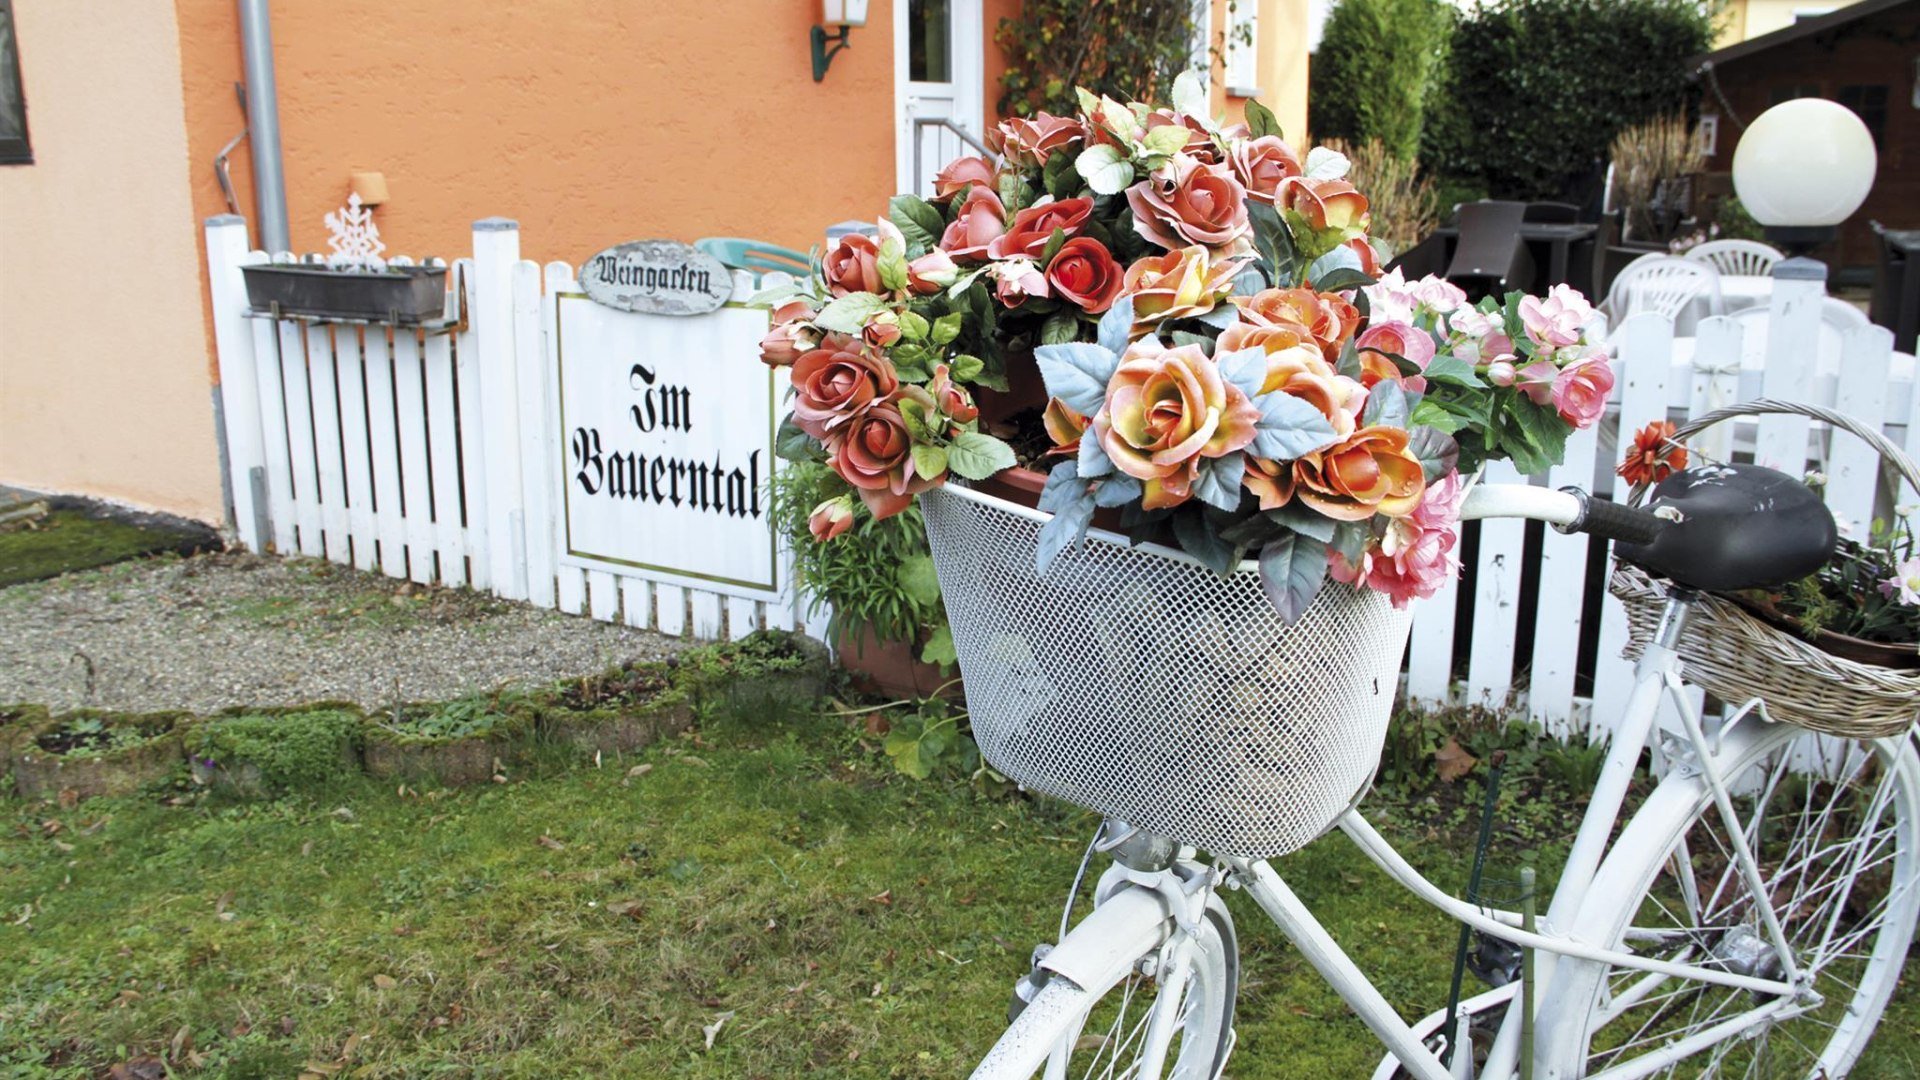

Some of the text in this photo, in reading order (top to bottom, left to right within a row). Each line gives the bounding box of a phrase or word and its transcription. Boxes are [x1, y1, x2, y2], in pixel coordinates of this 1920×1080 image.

[597, 255, 719, 297] Weingarten
[630, 363, 693, 433] Im
[573, 427, 762, 520] Bauerntal
